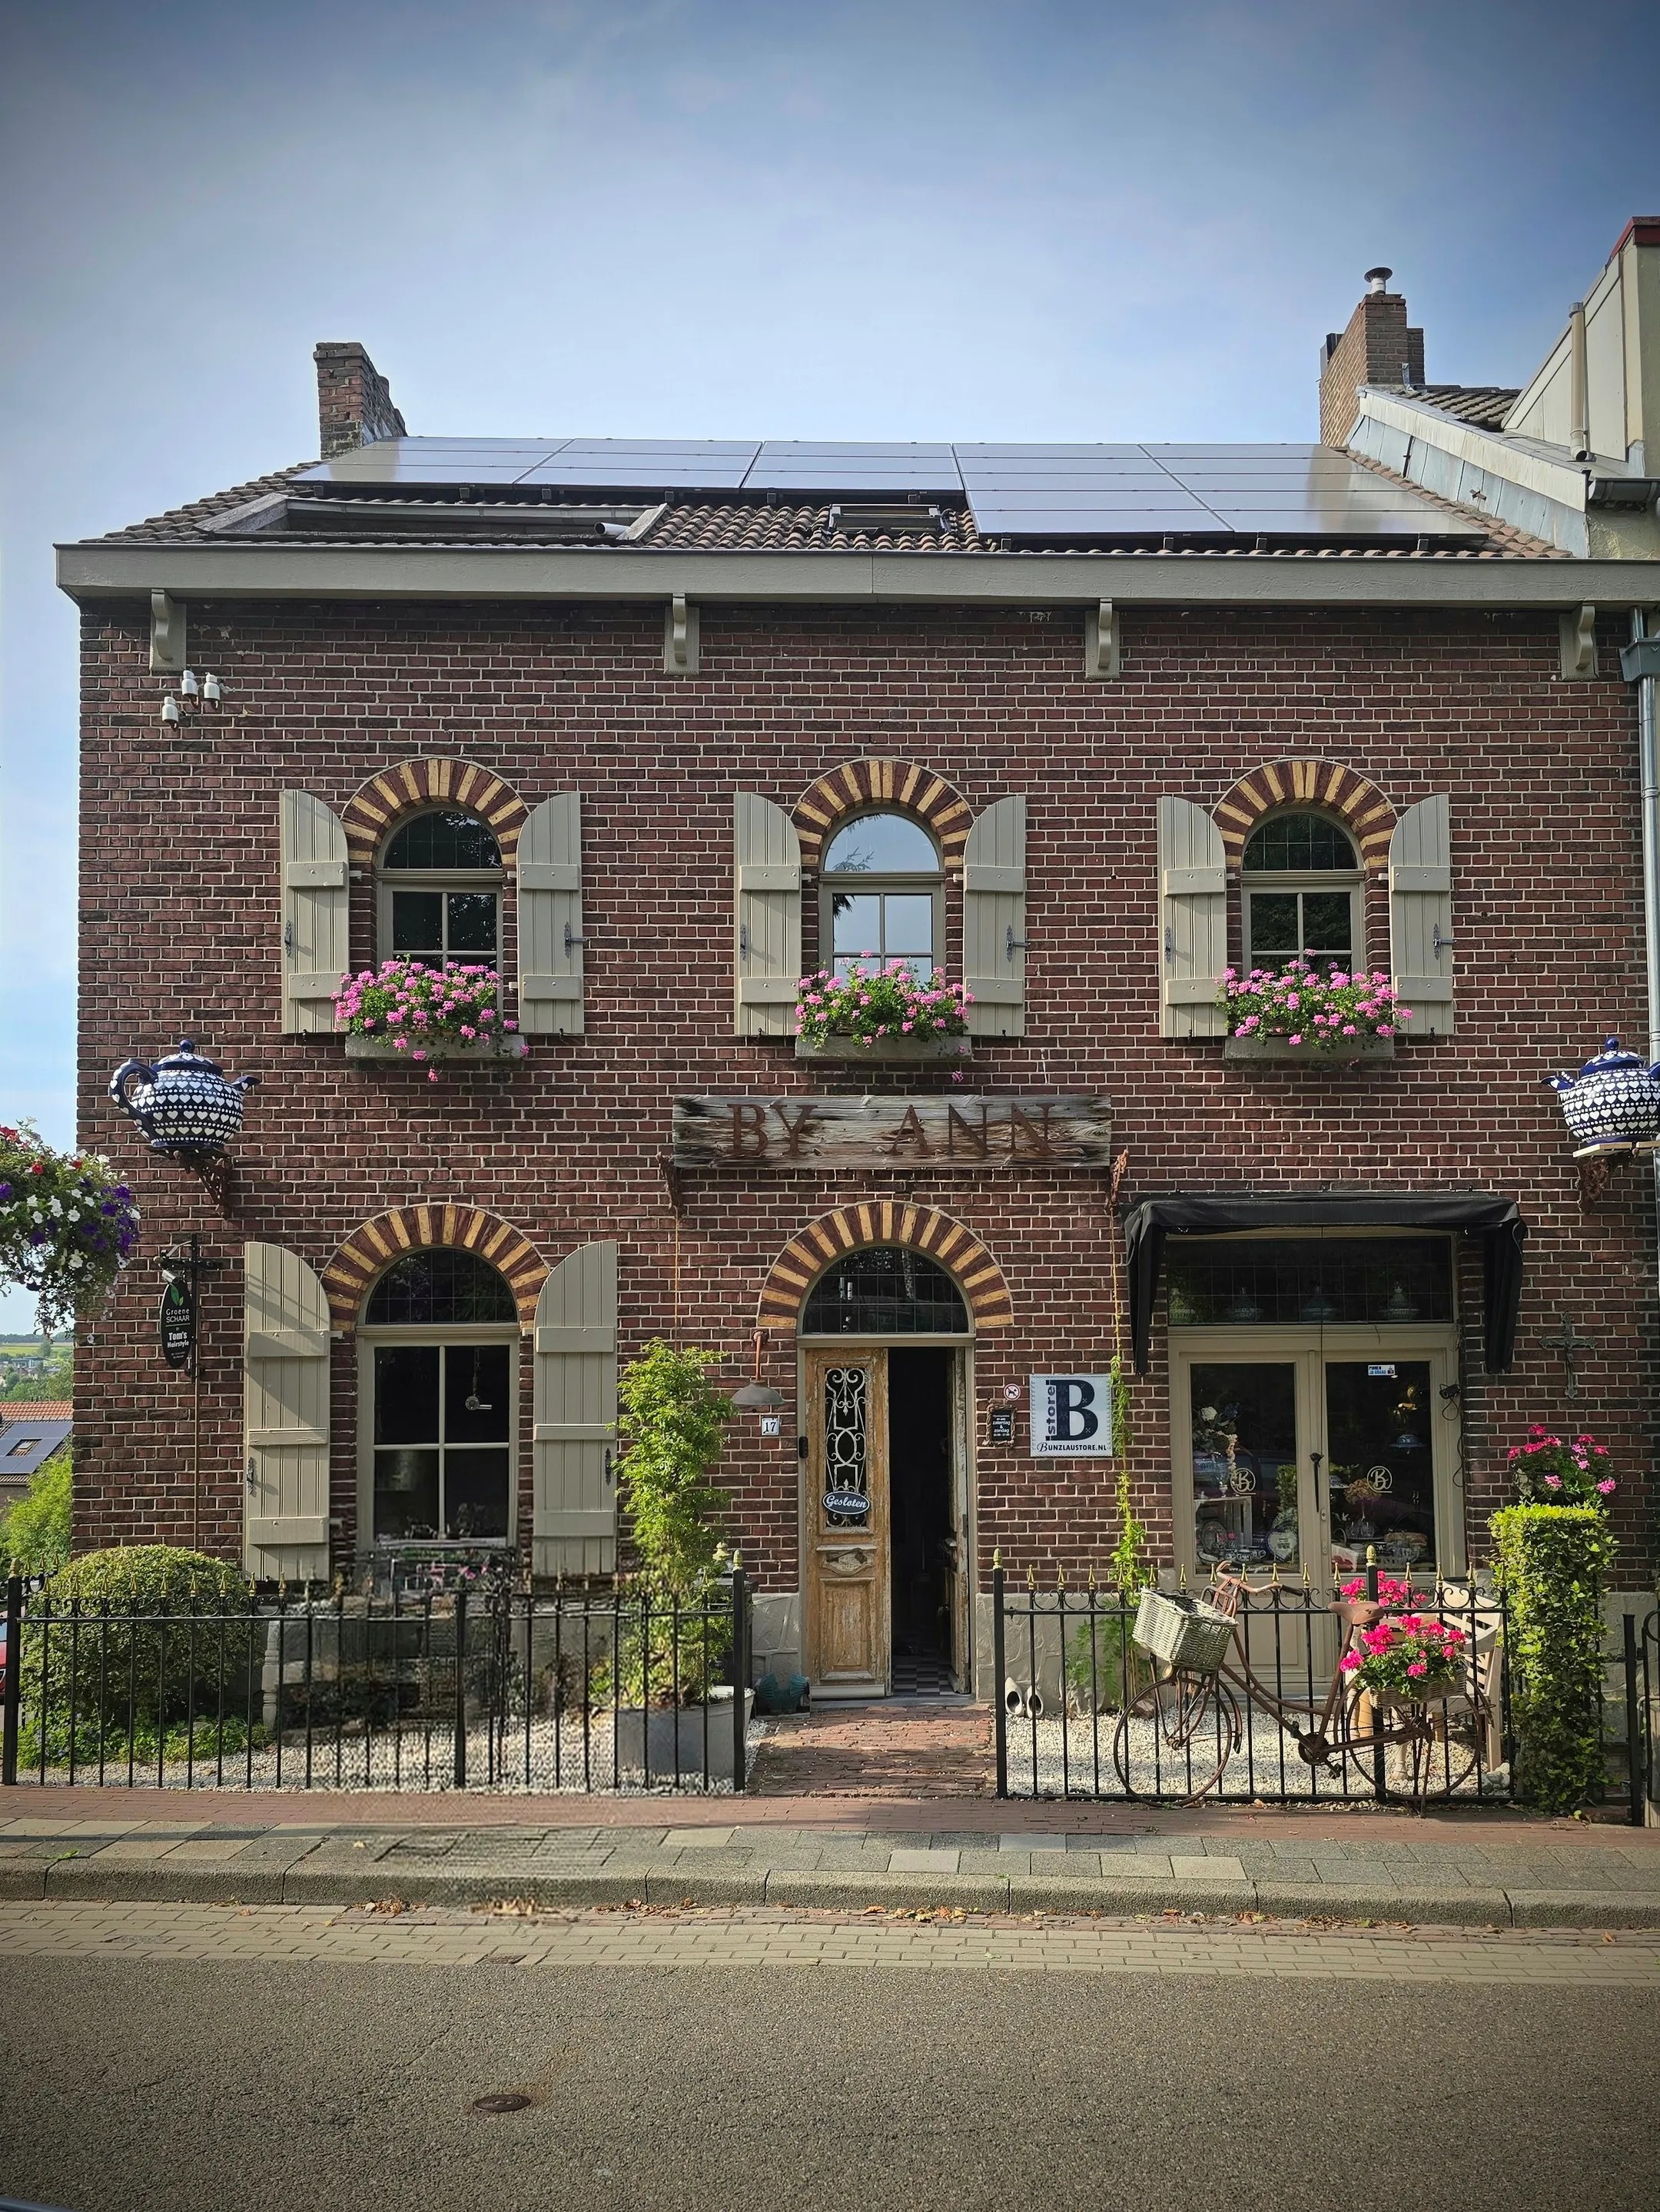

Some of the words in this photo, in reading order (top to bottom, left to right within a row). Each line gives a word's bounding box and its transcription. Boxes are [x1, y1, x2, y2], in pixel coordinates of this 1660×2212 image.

[726, 1103, 818, 1155] BY
[882, 1102, 1056, 1154] ANN
[166, 1314, 190, 1323] SCHAAR
[168, 1331, 187, 1340] Tom's
[167, 1340, 189, 1348] Hairstyle
[1045, 1379, 1098, 1441] B
[763, 1421, 776, 1434] 17
[1036, 1442, 1107, 1453] BUNZLAUSTORE.NL
[825, 1495, 867, 1509] Gesloten
